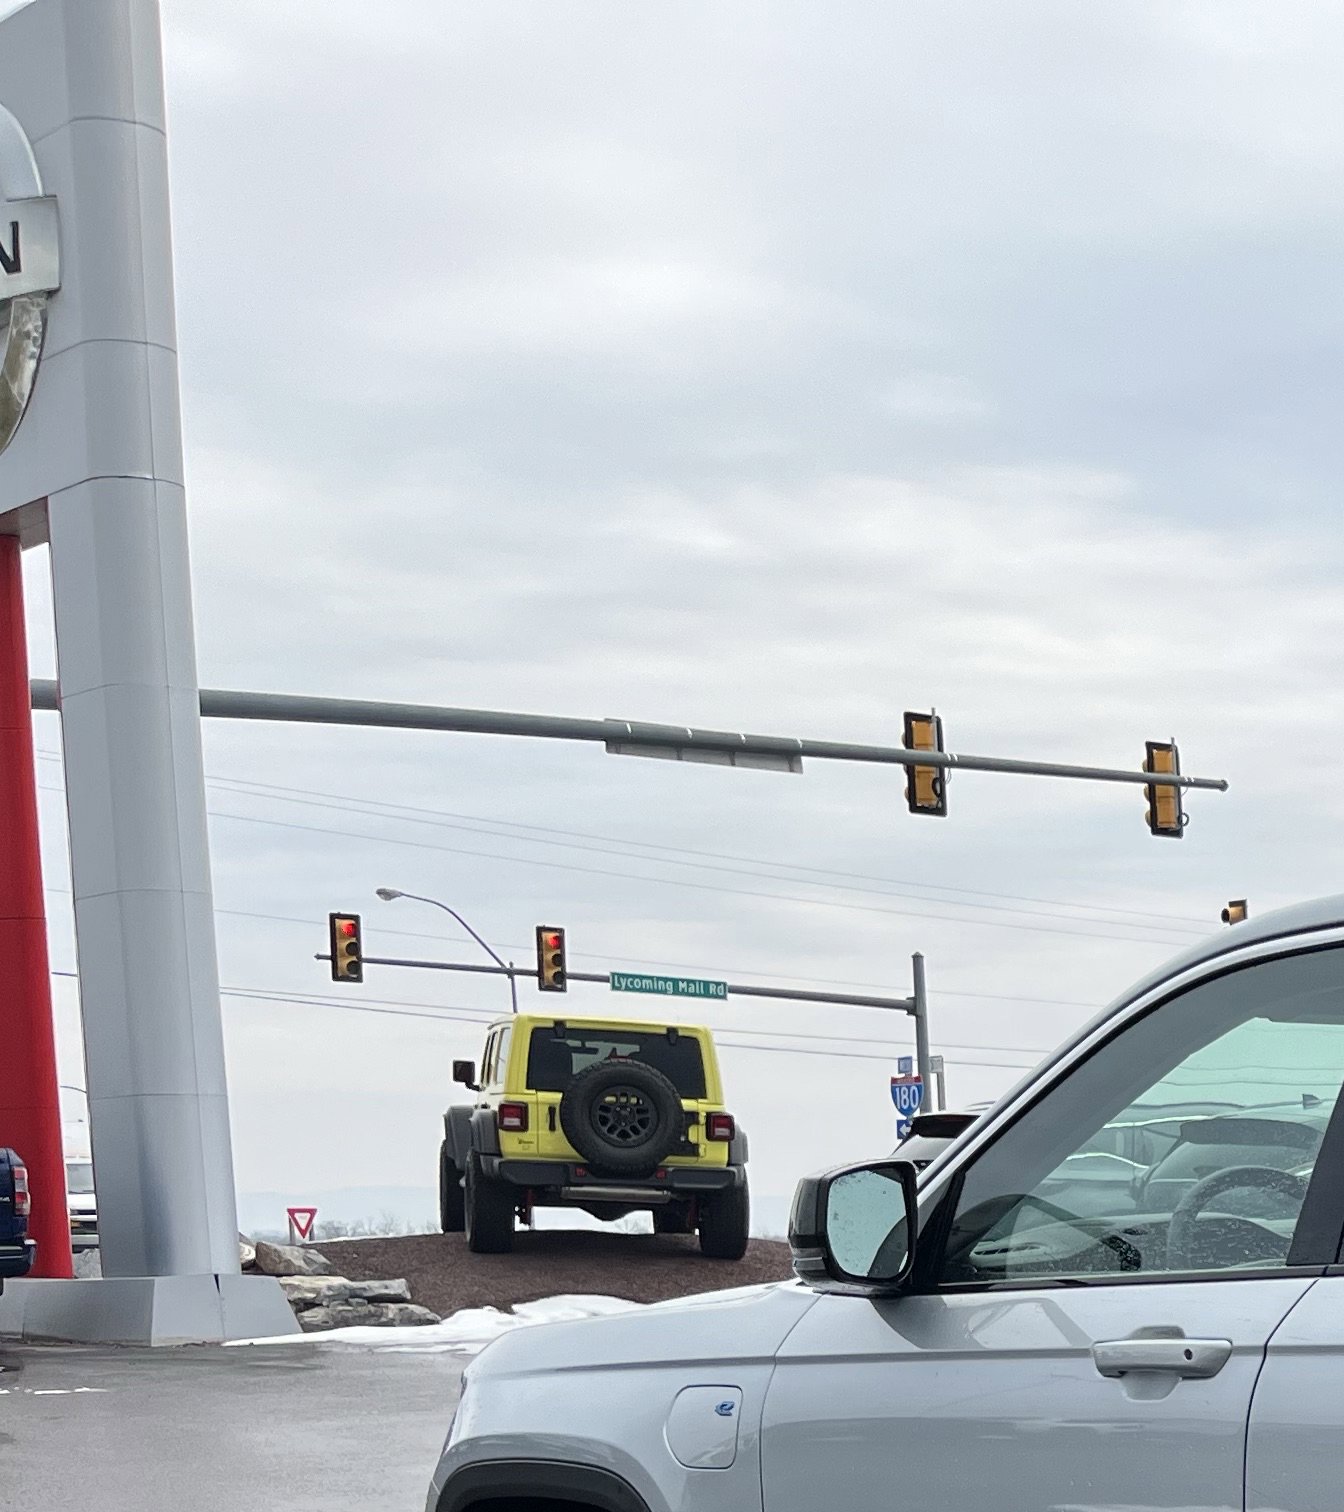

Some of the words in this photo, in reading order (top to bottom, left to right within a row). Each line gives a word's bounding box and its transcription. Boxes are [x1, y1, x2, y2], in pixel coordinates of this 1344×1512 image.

[614, 974, 674, 994] Lycoming
[678, 980, 704, 995] Mall
[709, 983, 725, 996] Rd
[896, 1086, 919, 1110] 180
